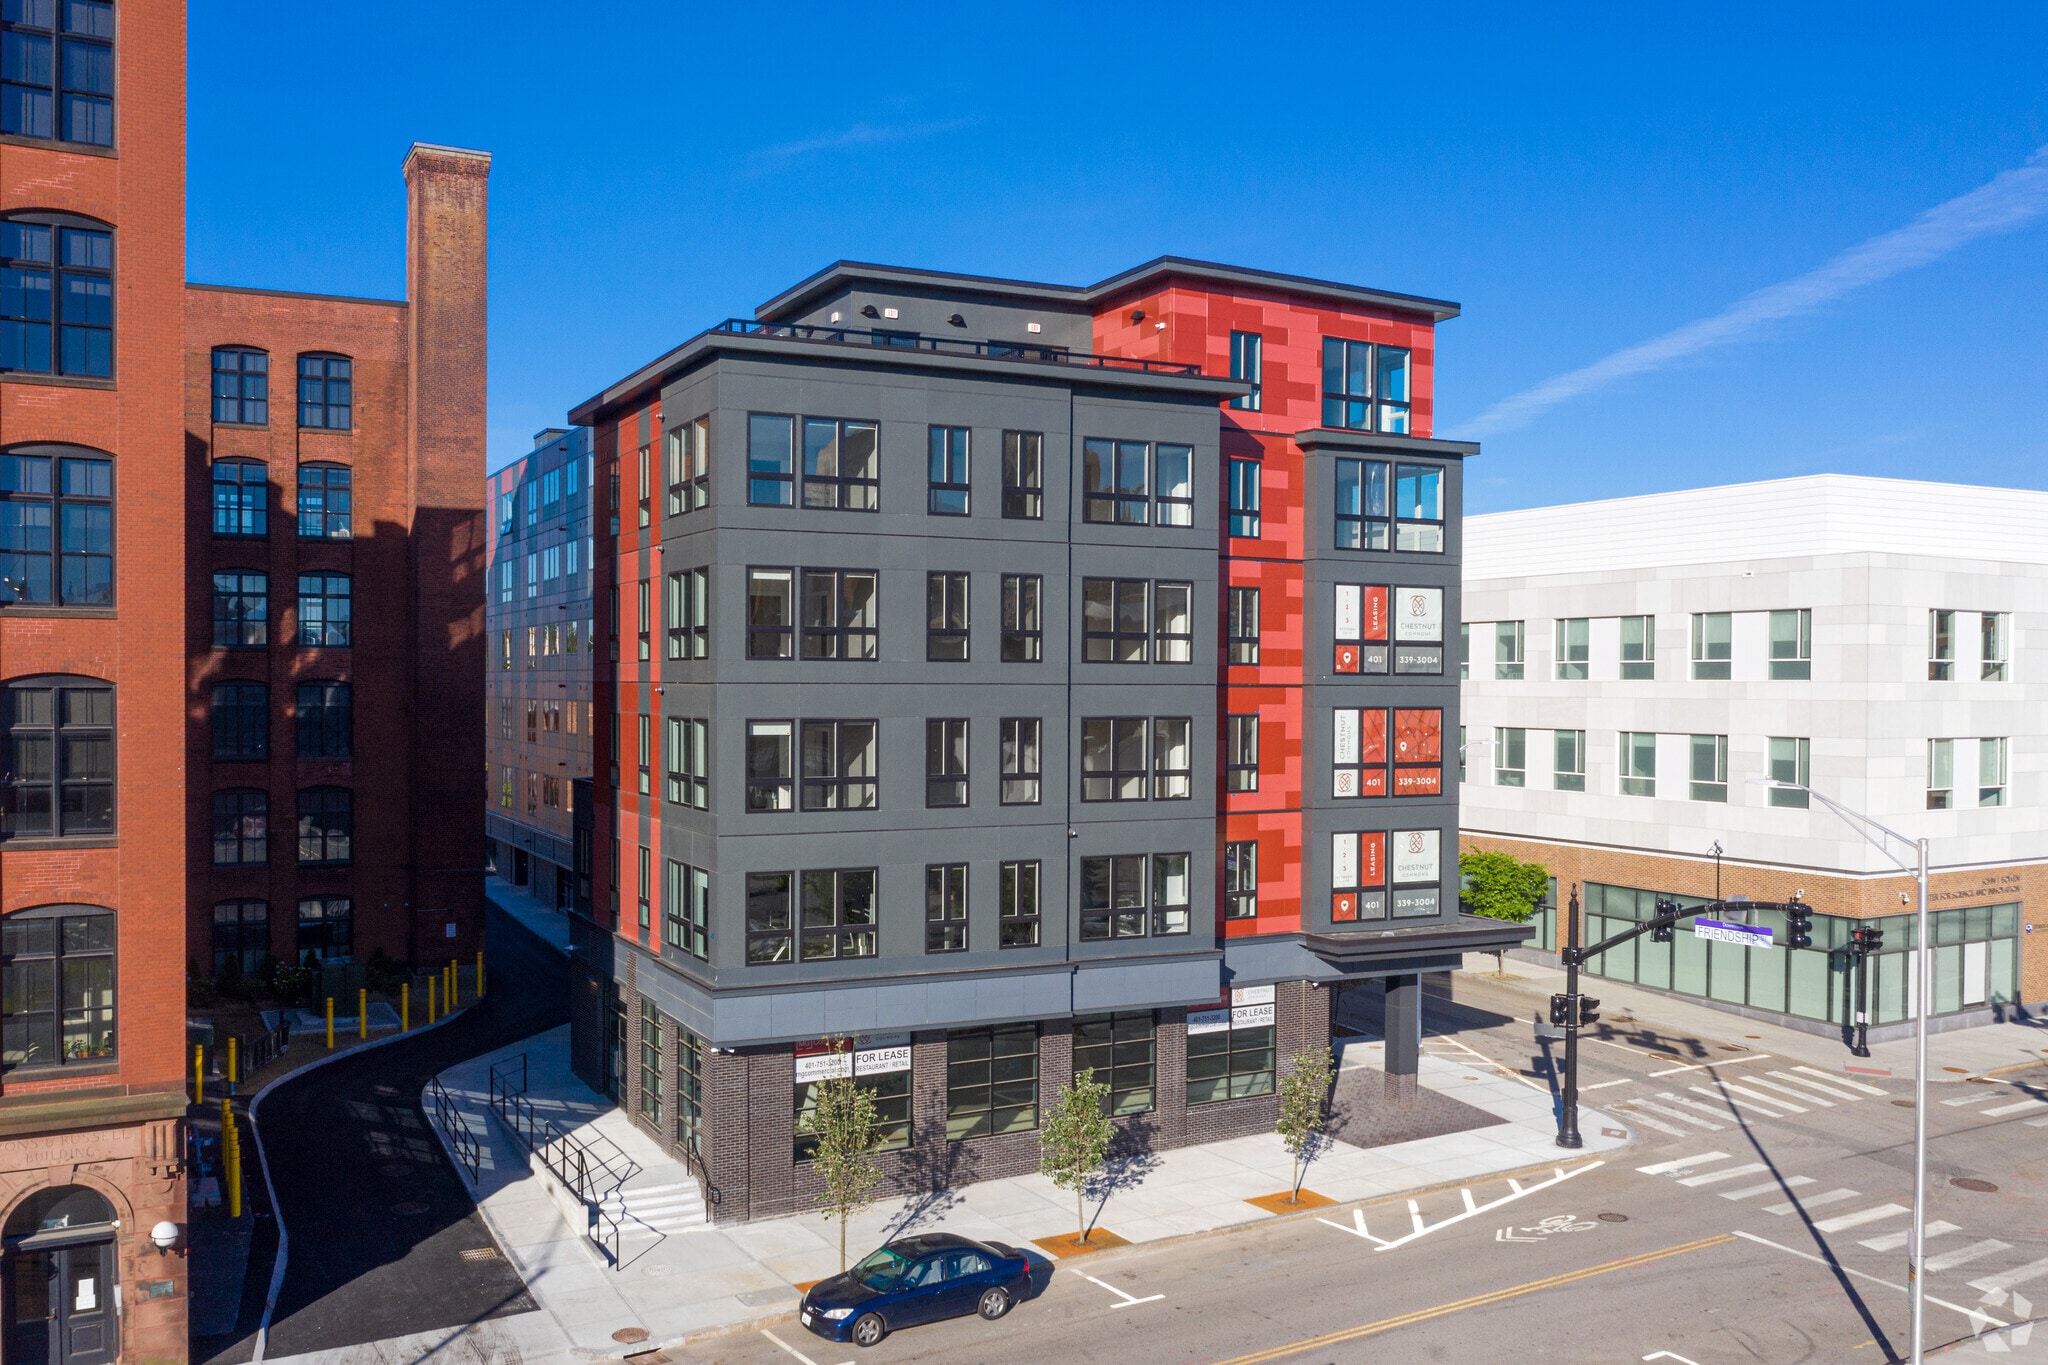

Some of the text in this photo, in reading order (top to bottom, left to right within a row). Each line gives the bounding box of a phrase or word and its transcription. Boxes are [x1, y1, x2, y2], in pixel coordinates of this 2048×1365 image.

[1400, 622, 1436, 630] CHESTNUT
[1367, 655, 1438, 664] 401 339-3004
[1366, 777, 1437, 786] 401 339-3004
[1397, 863, 1433, 872] CHESTNUT
[1365, 898, 1435, 909] 401 339-3004
[1698, 926, 1759, 944] FRIENDSHIP
[1232, 1006, 1273, 1018] FOR LEASE
[856, 1048, 909, 1064] FOR LEASE
[856, 1062, 889, 1072] RESTAURANT
[892, 1060, 909, 1068] RETAIL
[61, 1129, 132, 1145] RUSSELL
[26, 1147, 95, 1163] BUILDING
